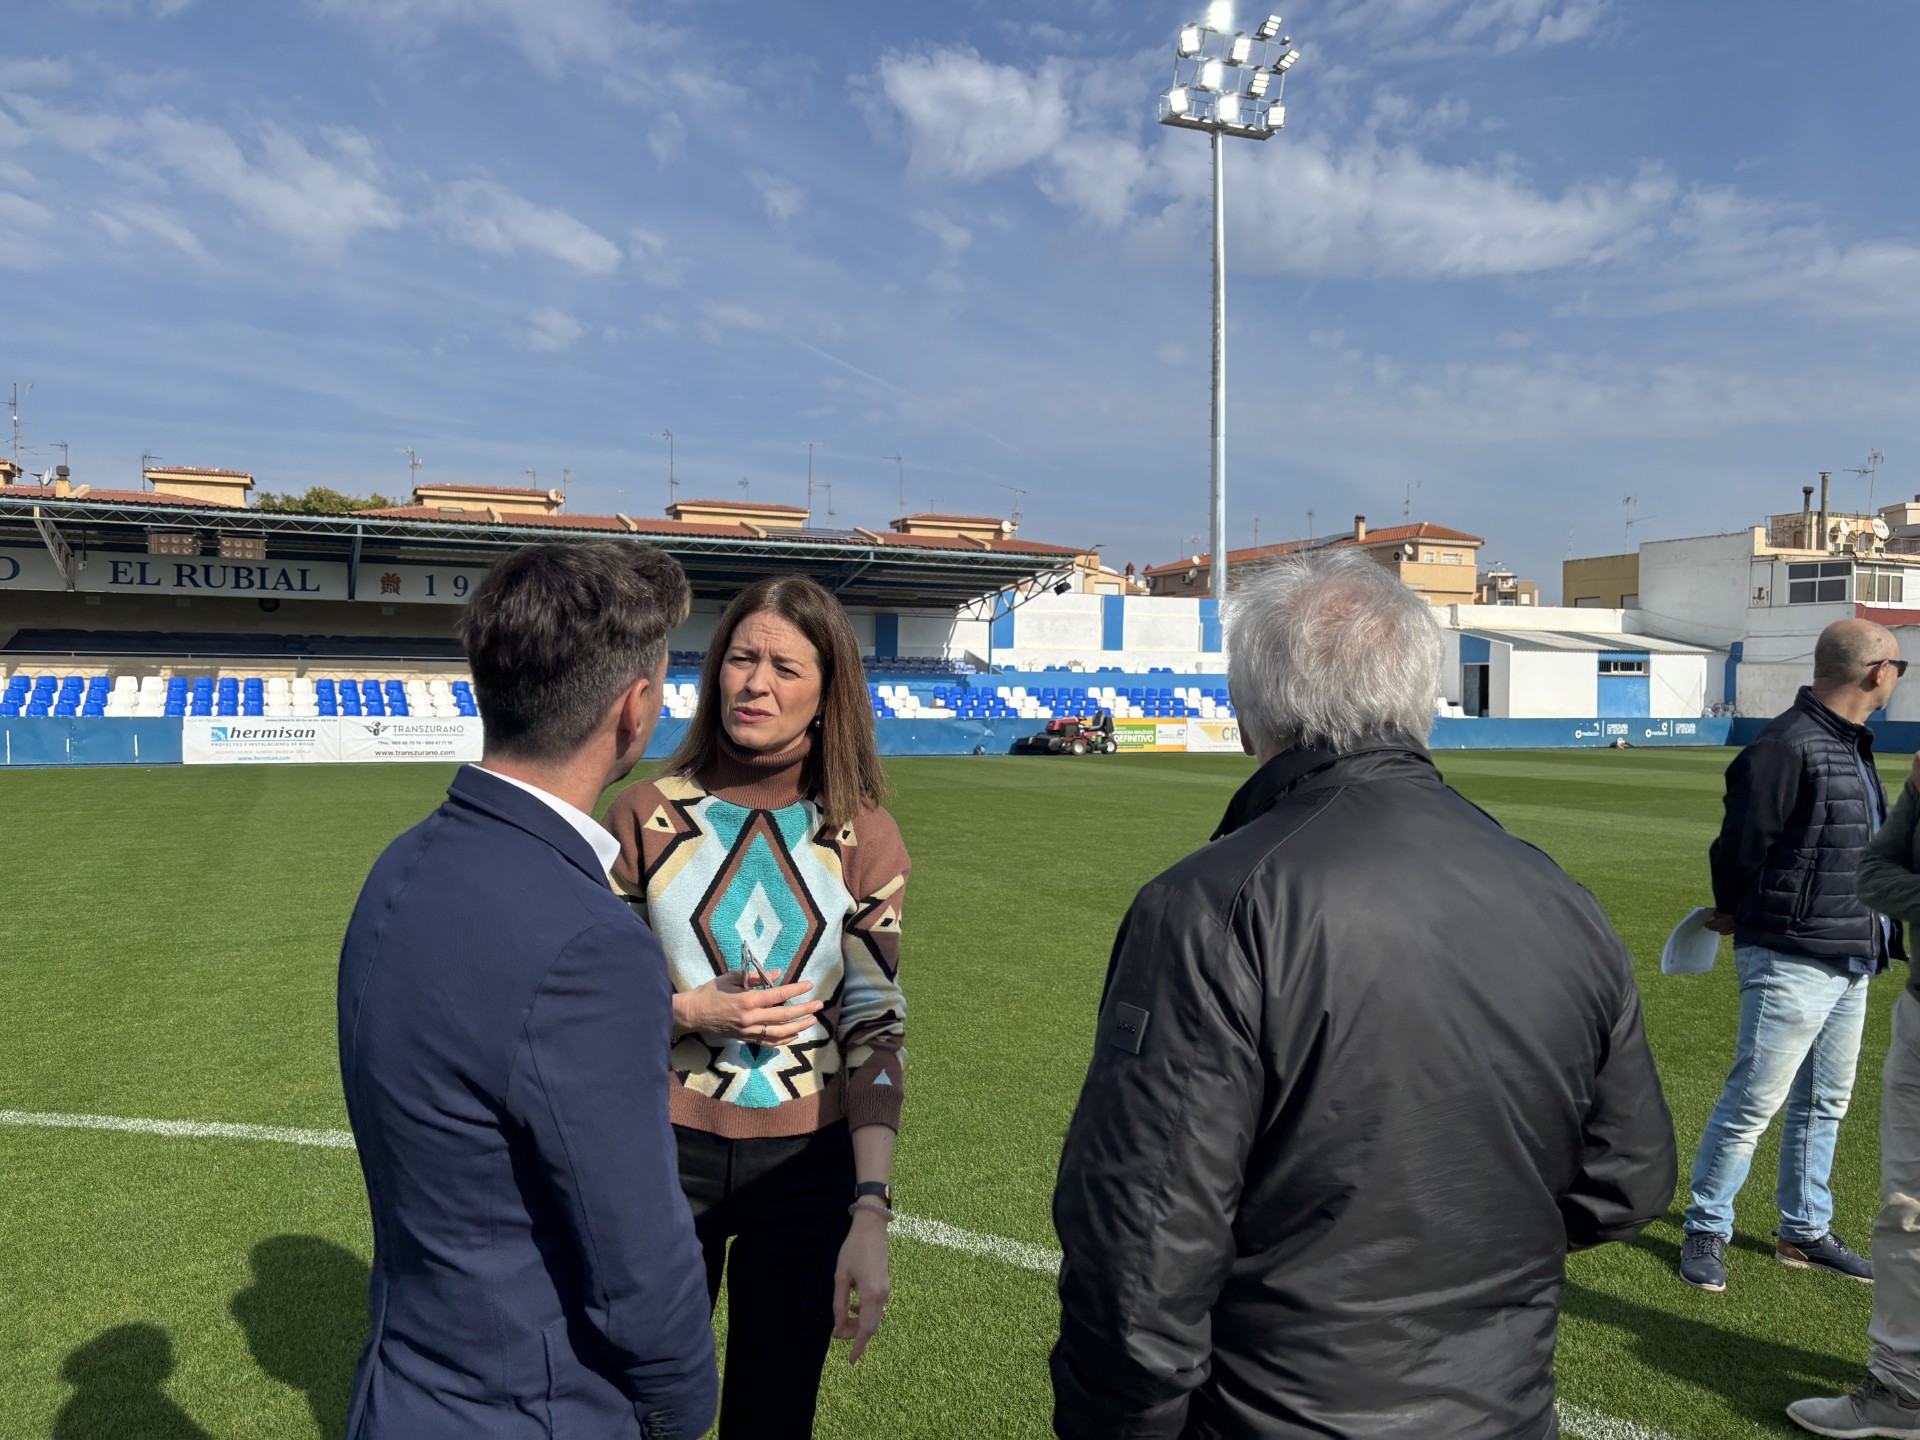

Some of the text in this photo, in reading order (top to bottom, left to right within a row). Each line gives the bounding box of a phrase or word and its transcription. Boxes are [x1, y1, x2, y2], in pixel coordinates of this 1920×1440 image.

[108, 560, 321, 592] EL RUBIAL
[230, 727, 316, 738] hermisan
[1113, 735, 1154, 743] DEFINITIVO
[1221, 726, 1239, 741] CR
